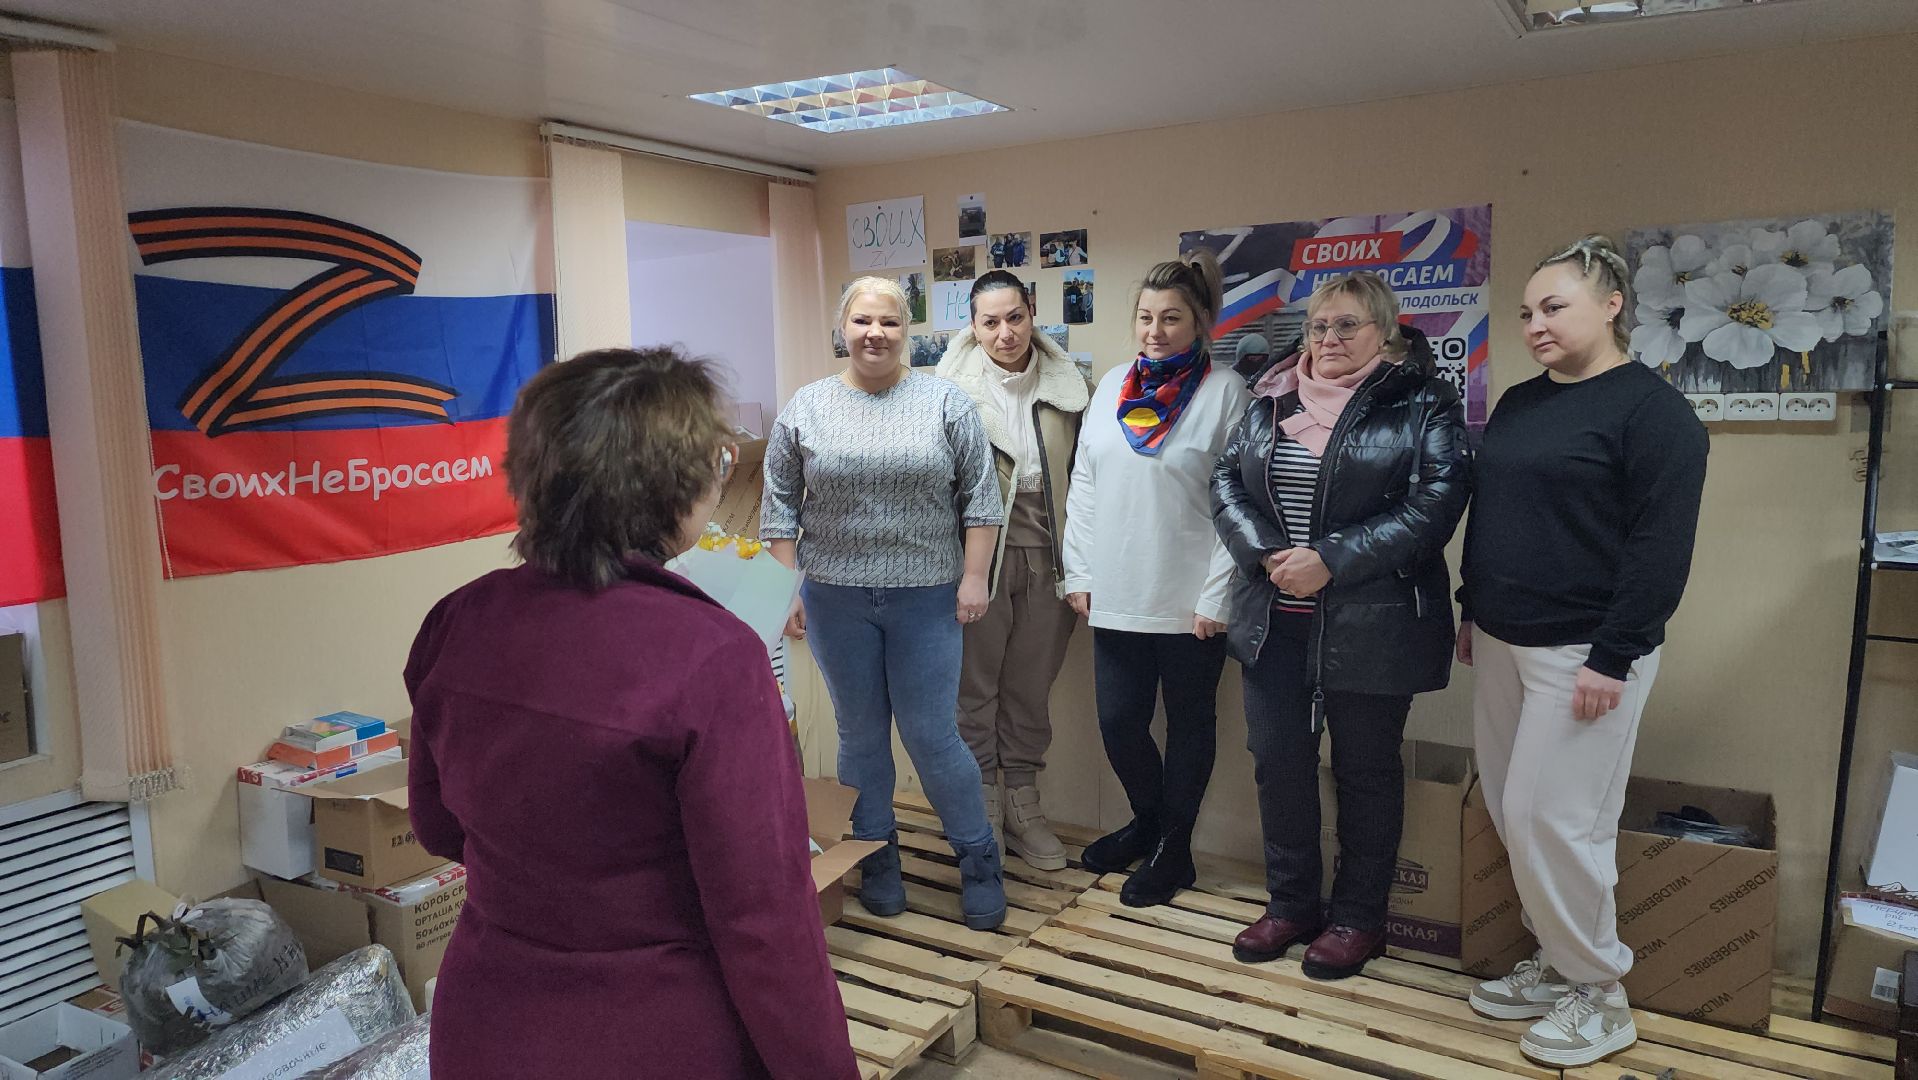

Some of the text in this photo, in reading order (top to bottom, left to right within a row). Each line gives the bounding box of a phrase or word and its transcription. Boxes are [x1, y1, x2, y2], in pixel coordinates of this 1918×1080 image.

[1302, 238, 1383, 265] СВОИХ
[1312, 272, 1341, 293] Н
[152, 455, 493, 501] СвоихНеБросаем
[414, 891, 450, 914] КОРОБ
[452, 883, 468, 898] СР
[1618, 875, 1692, 925] WILDBERRIES
[415, 904, 454, 927] ОРТАША
[1683, 928, 1761, 978] WILDBERRIES
